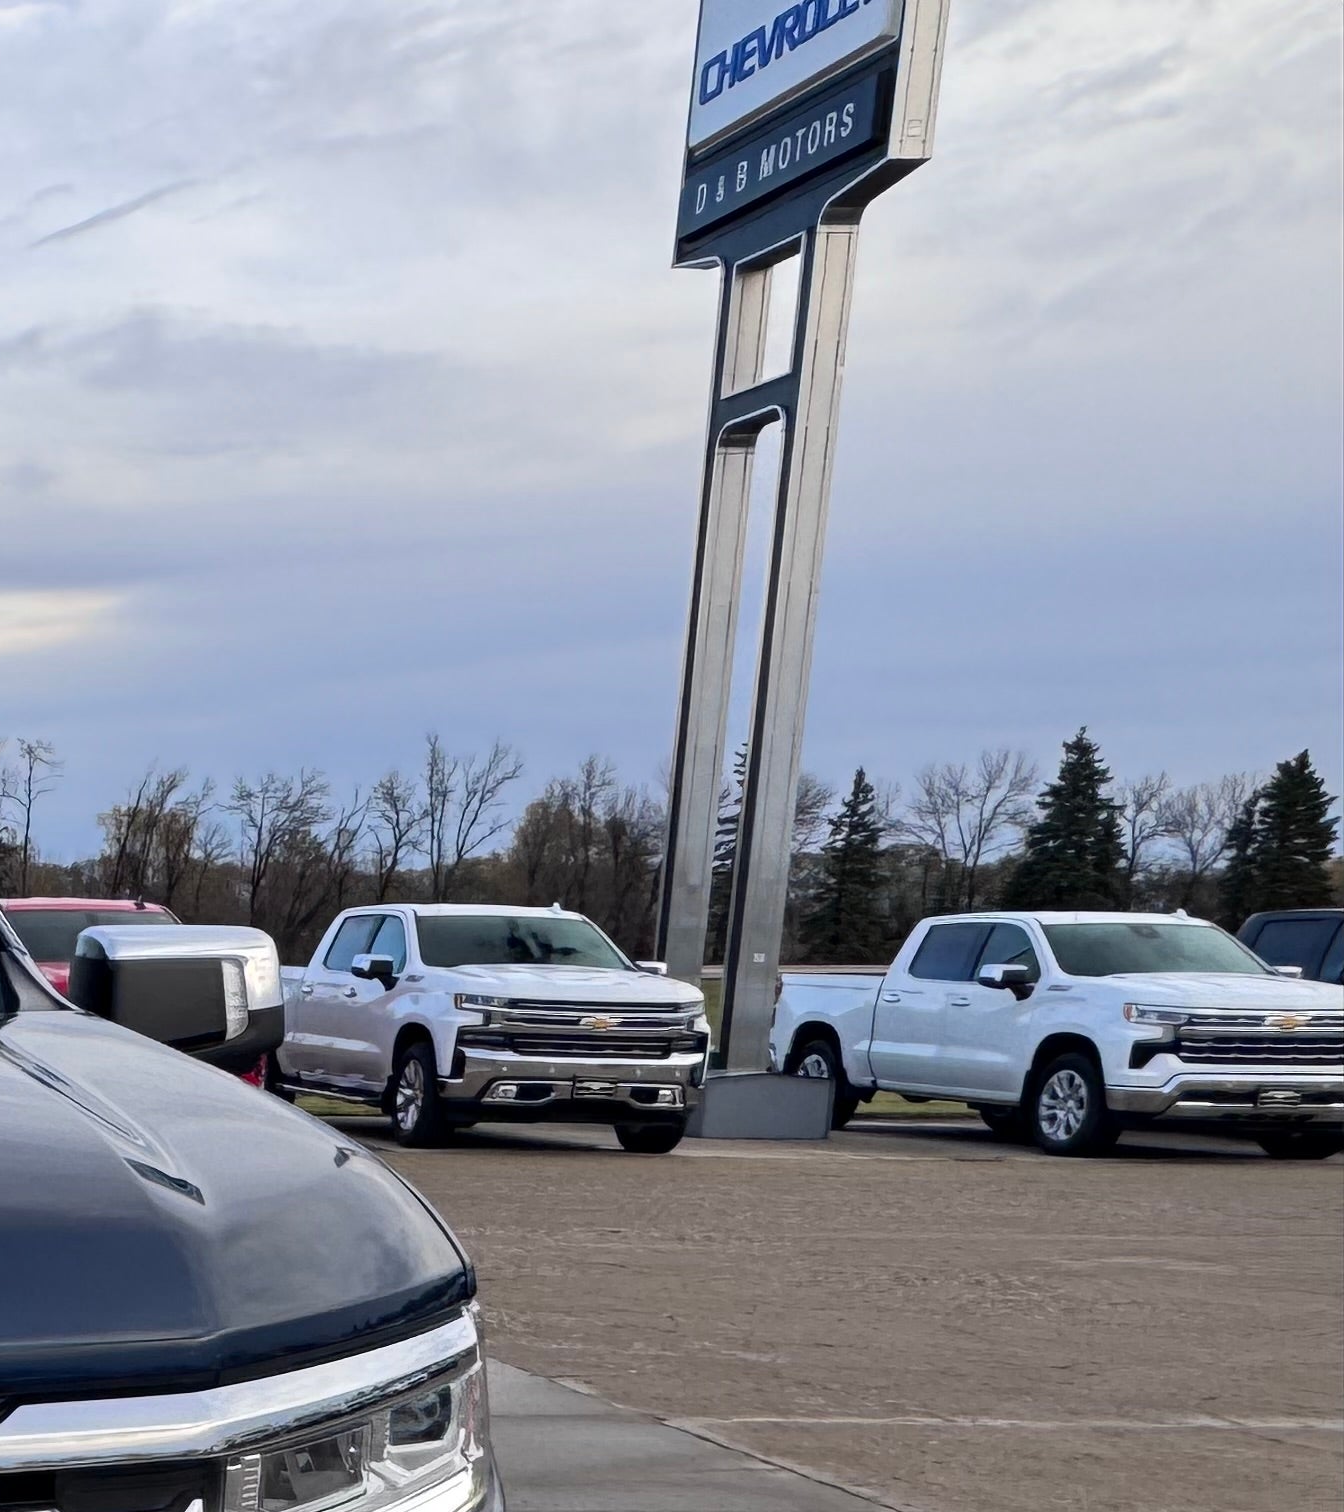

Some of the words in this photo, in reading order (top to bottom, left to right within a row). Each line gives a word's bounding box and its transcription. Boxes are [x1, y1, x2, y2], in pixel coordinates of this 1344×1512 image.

[698, 0, 870, 105] CHEVROL
[696, 183, 707, 215] D
[736, 160, 748, 192] B
[759, 102, 855, 181] MOTORS
